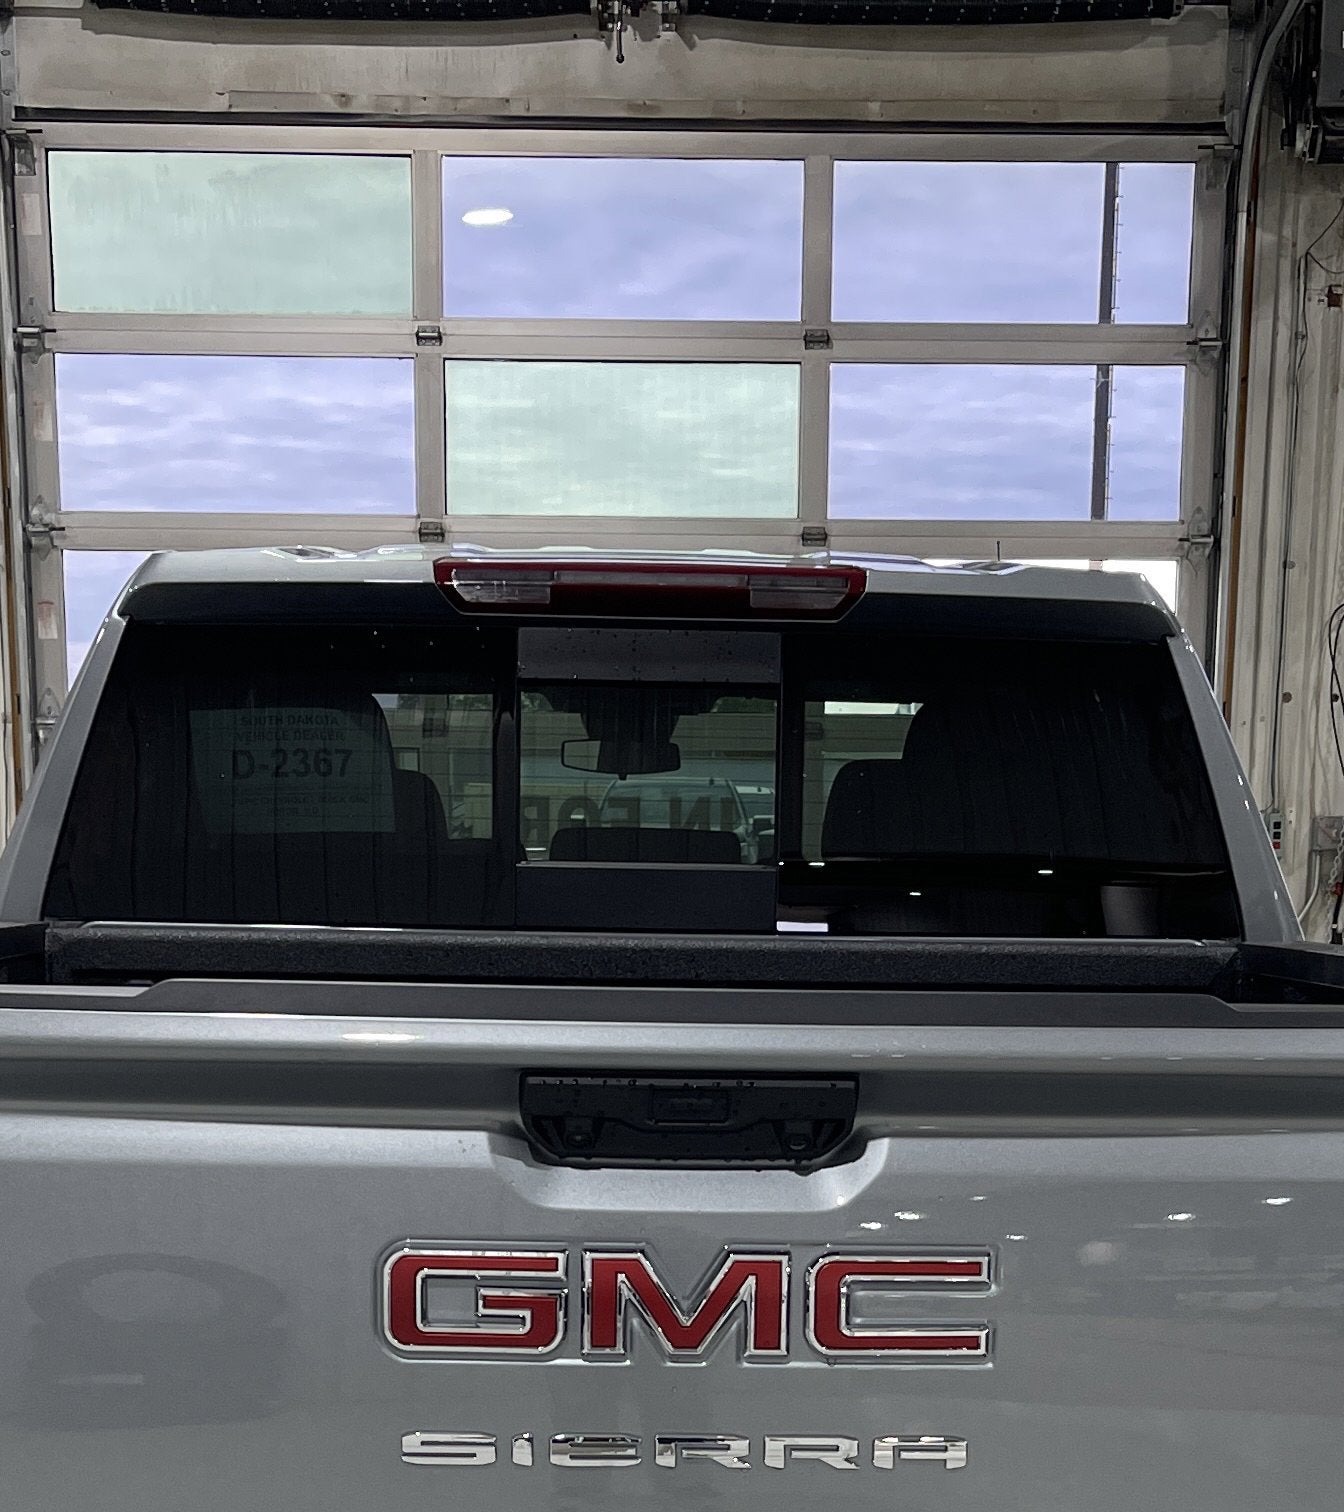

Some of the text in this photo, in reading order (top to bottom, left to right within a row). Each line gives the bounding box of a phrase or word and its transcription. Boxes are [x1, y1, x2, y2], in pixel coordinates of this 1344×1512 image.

[232, 748, 353, 779] D-2367
[380, 1245, 993, 1358] GMC
[401, 1431, 968, 1470] SIERRA
